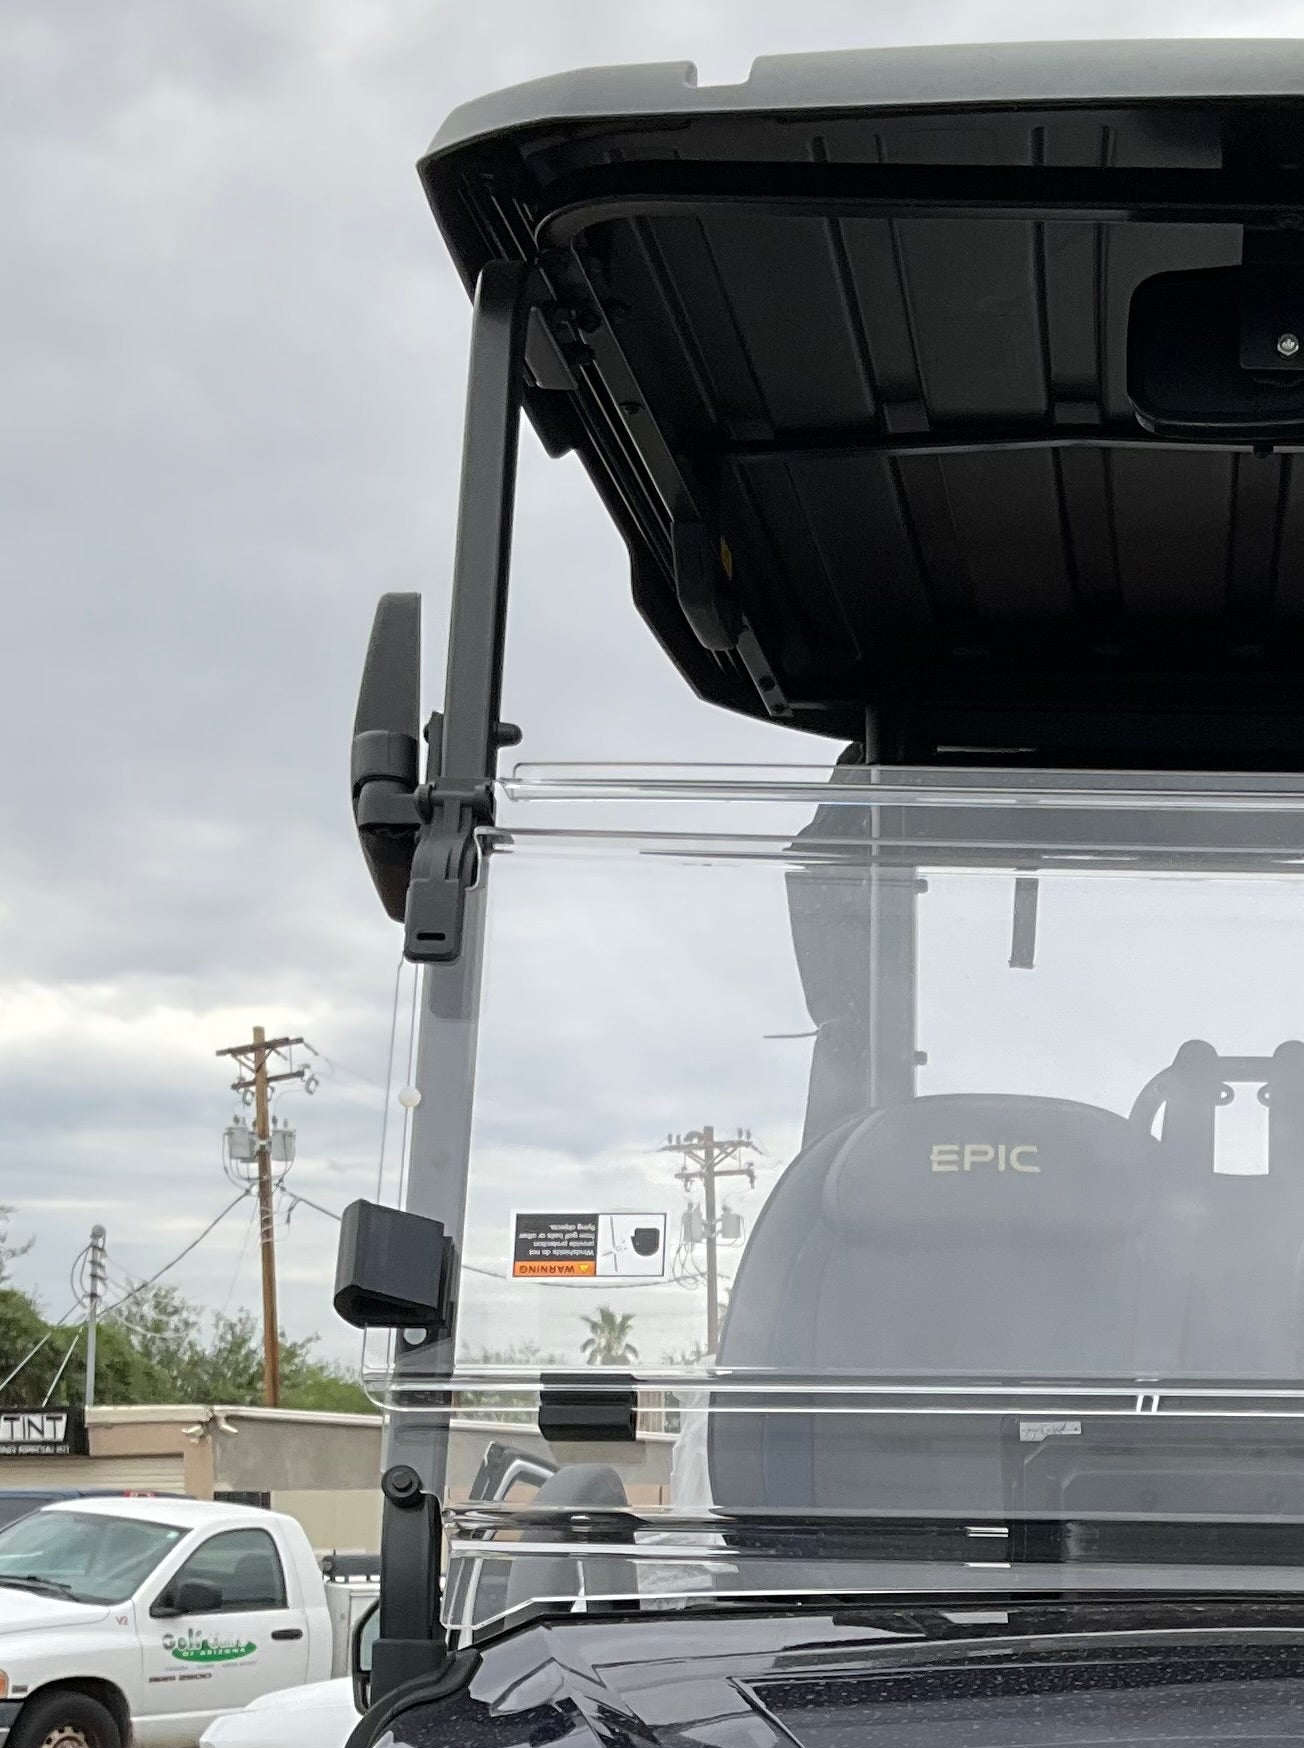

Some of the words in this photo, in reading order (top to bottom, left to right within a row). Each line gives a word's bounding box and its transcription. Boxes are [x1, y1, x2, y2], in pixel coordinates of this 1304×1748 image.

[930, 1144, 1041, 1172] EPIC
[565, 1231, 578, 1239] golf
[520, 1265, 575, 1274] WARNING
[2, 1413, 65, 1441] TINT
[162, 1628, 202, 1650] Golf
